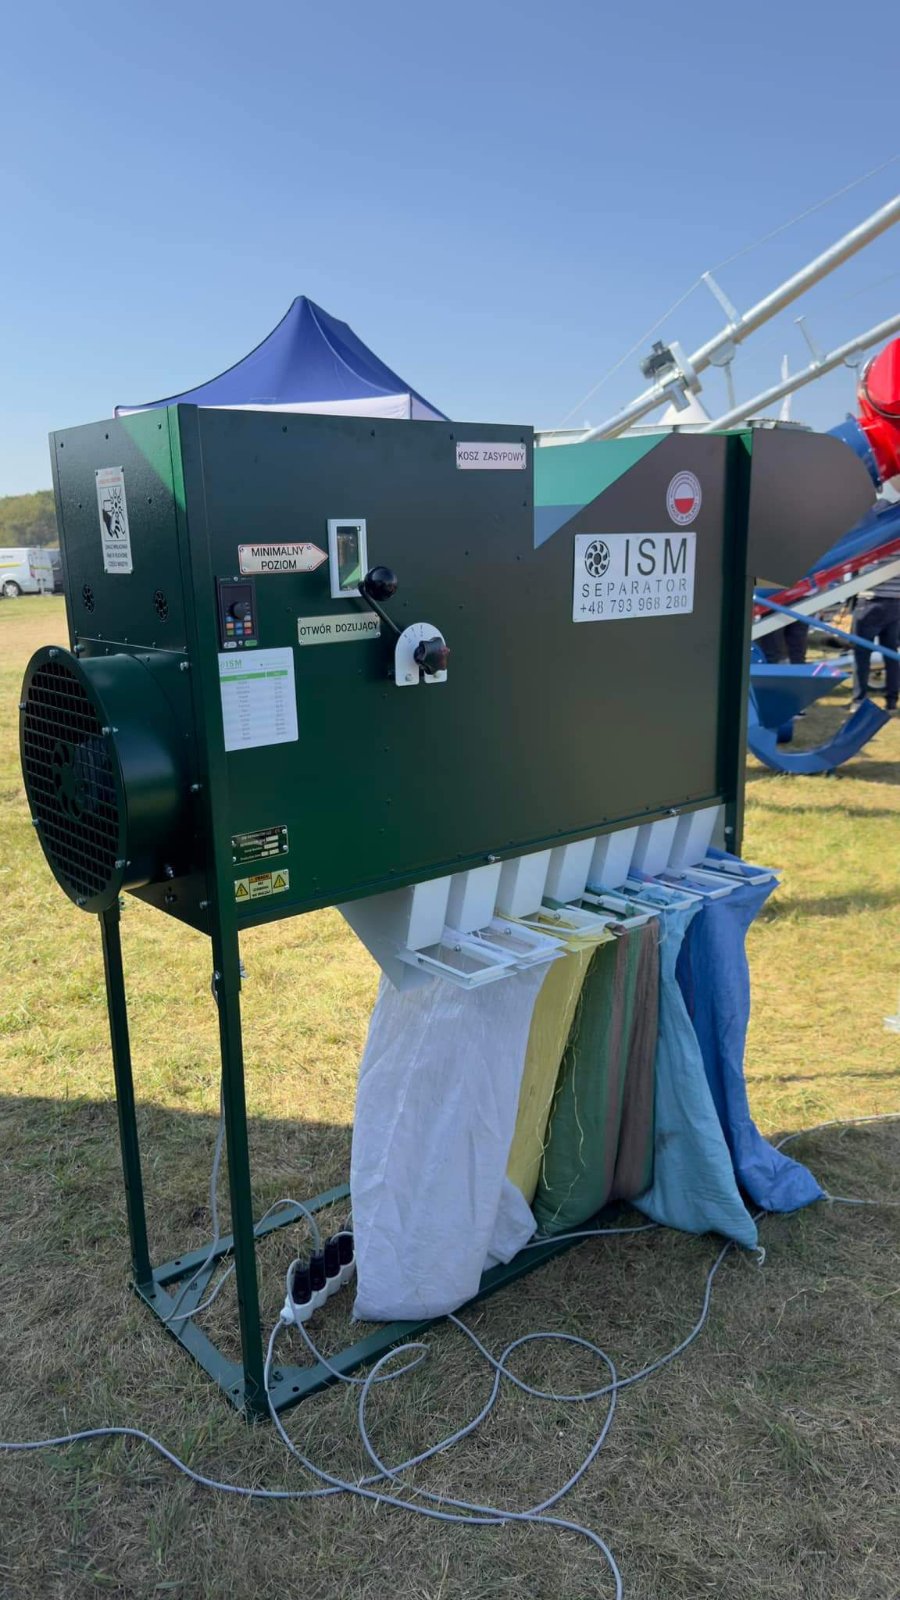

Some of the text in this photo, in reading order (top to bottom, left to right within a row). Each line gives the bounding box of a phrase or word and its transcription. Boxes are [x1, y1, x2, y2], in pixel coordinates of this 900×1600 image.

[457, 451, 525, 462] KOSZ ZASYPOWY
[251, 545, 305, 557] MINIMALNY
[624, 537, 688, 577] ISM
[260, 560, 297, 571] POZIOM
[581, 577, 688, 598] SEPARATOR
[580, 594, 688, 615] +48 793 968 280
[300, 620, 379, 636] OTWÓR DOZUJĄCY
